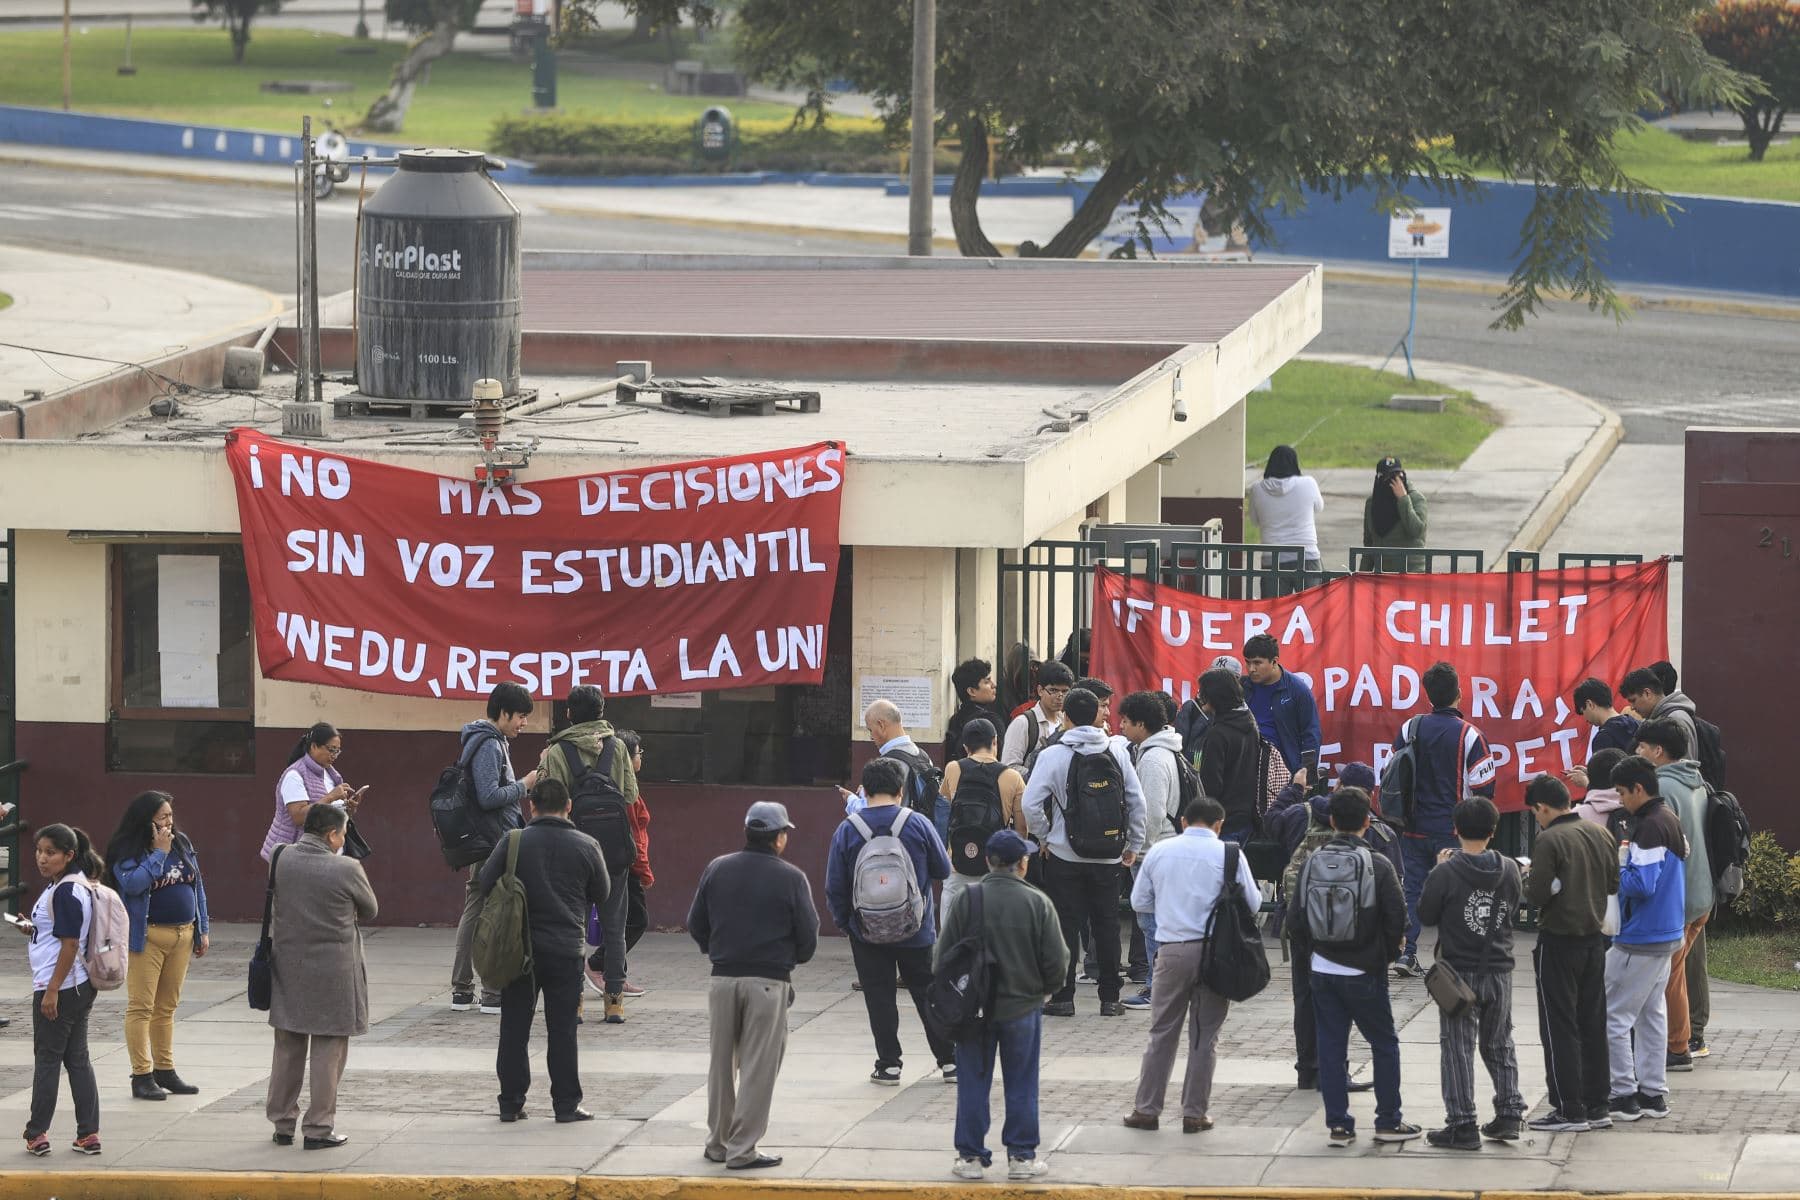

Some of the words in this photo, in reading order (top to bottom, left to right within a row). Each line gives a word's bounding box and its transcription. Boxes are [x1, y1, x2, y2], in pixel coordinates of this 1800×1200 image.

[418, 353, 440, 364] 1100
[578, 450, 842, 515] DECISIONES
[286, 528, 365, 577] SIN
[396, 538, 495, 588] VOZ
[521, 527, 827, 594] ESTUDIANTIL
[1385, 594, 1588, 646] CHILET
[446, 648, 657, 697] RESPETA
[679, 633, 742, 681] LA
[756, 624, 824, 673] UNI
